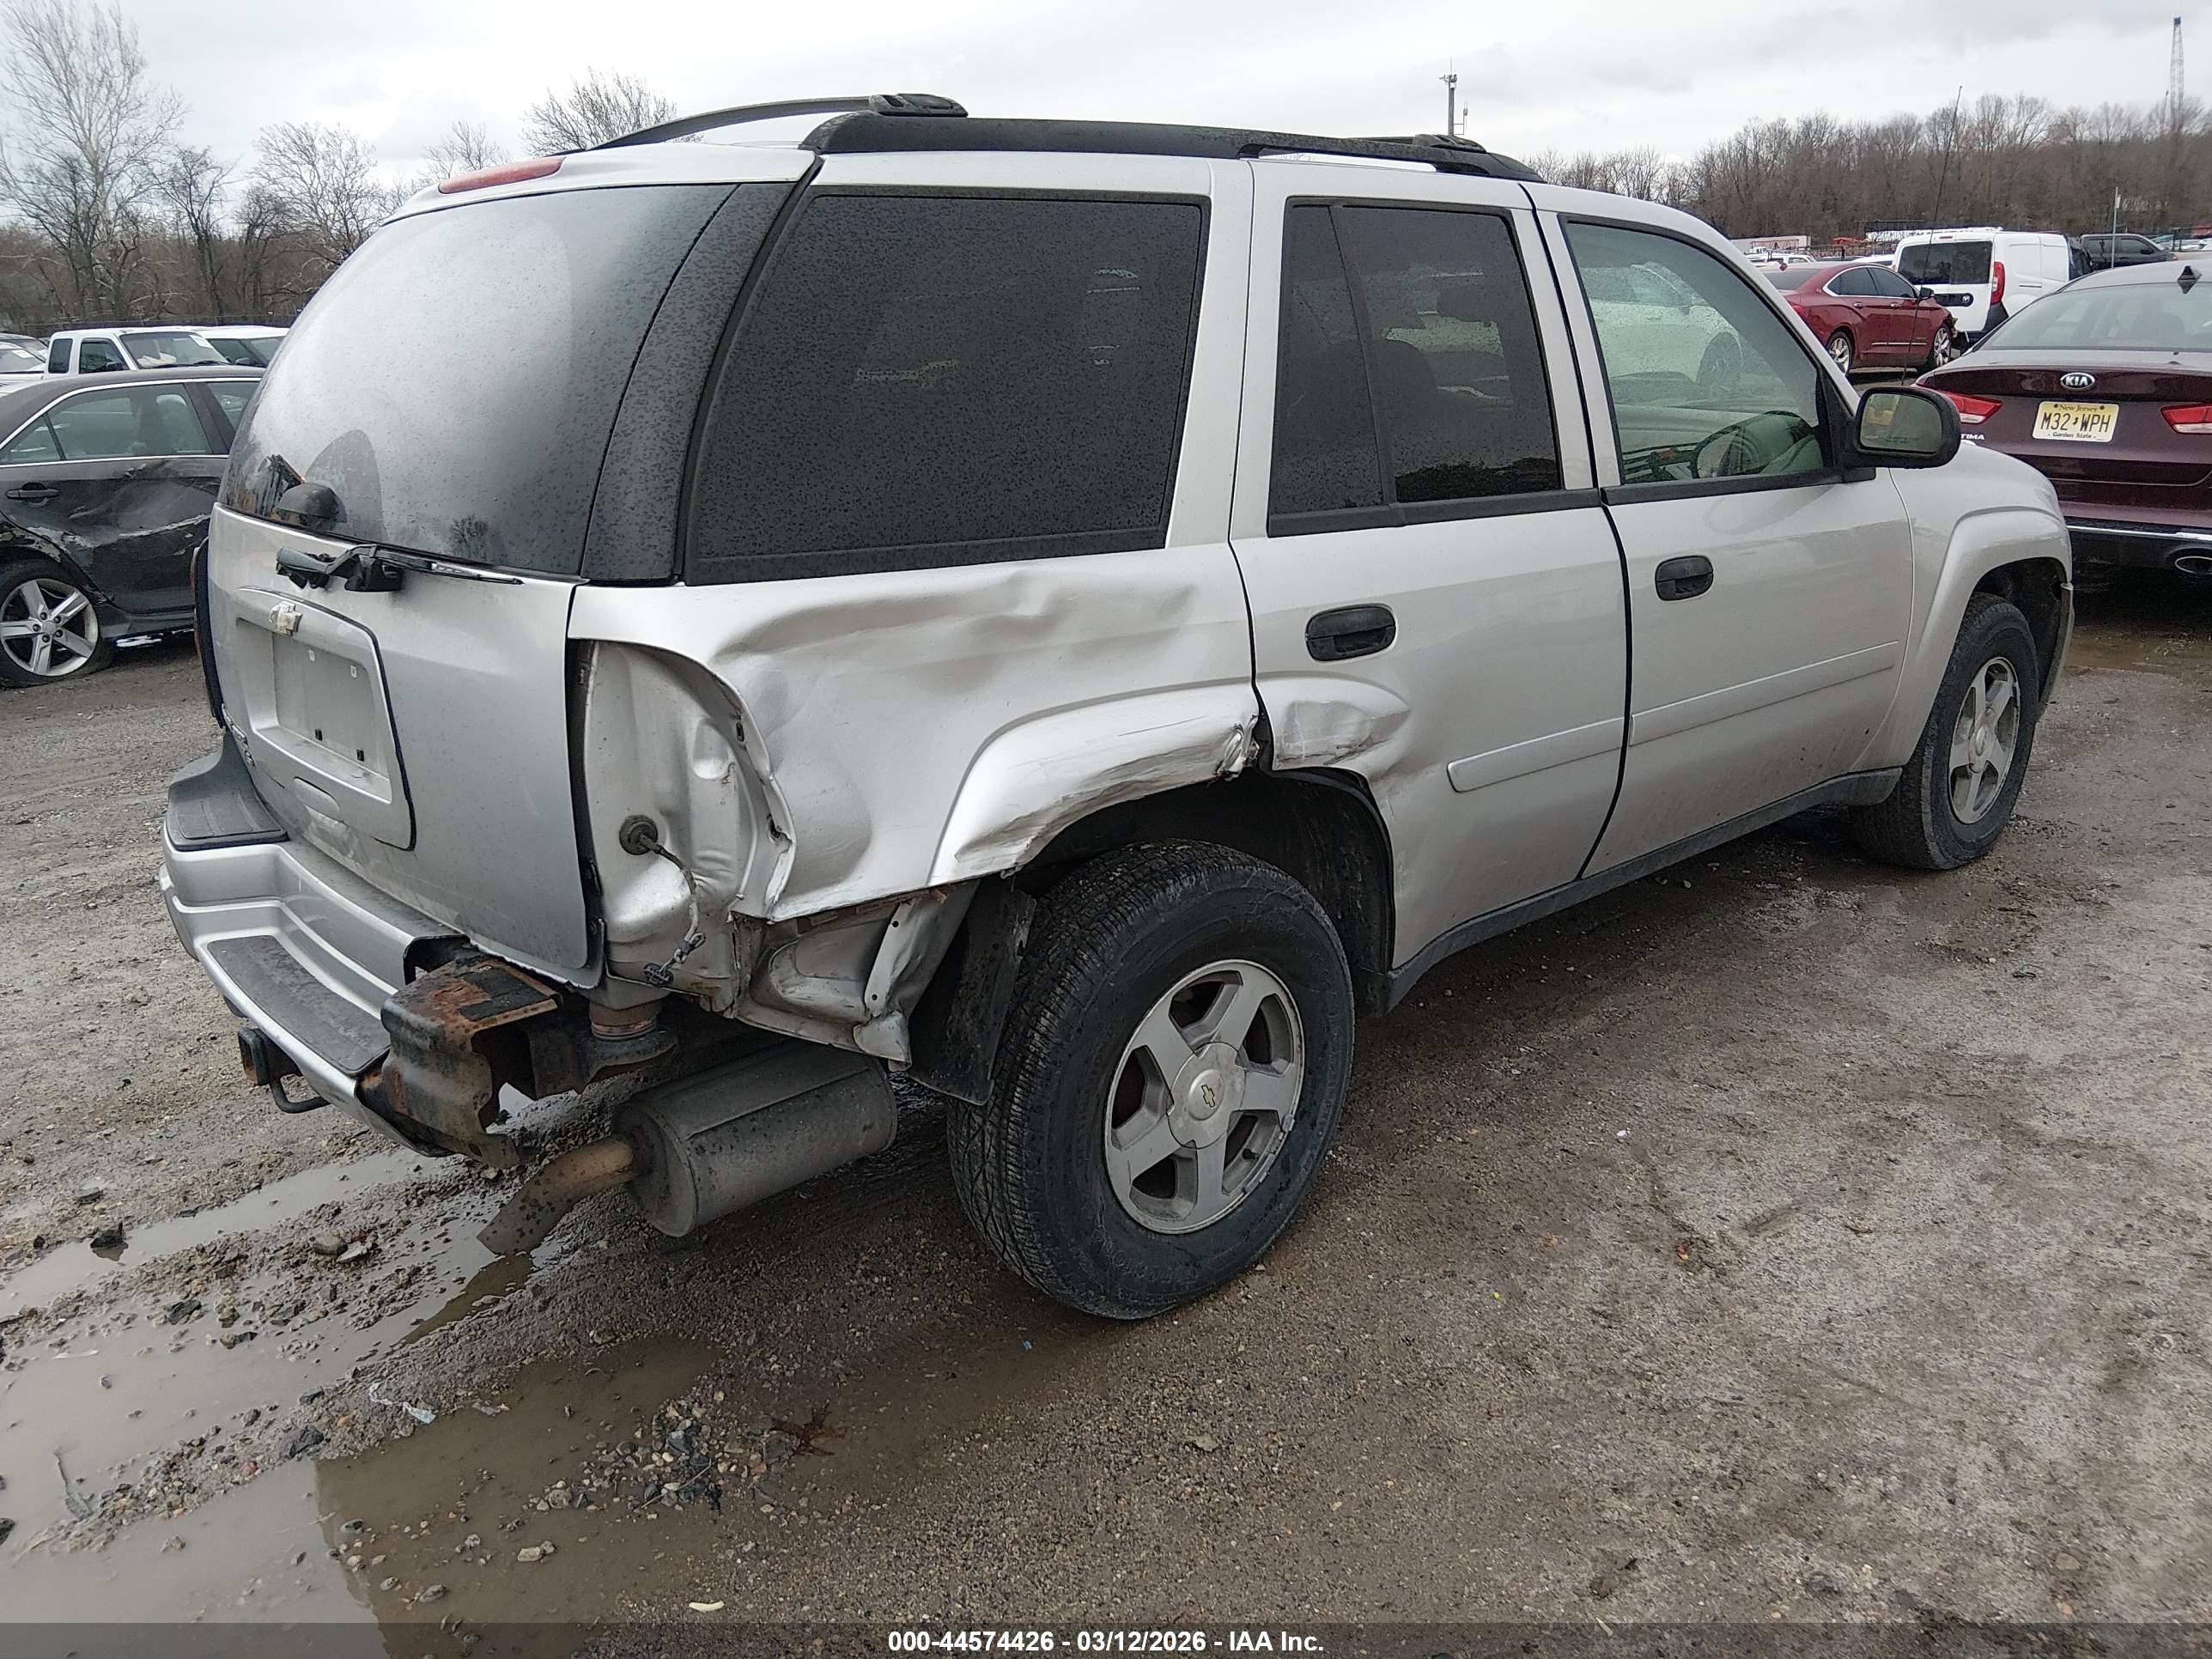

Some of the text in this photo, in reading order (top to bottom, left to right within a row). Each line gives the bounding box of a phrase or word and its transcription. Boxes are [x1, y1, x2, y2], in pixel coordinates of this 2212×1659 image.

[2065, 376, 2088, 386] KIA
[2040, 412, 2112, 433] M32 WPH
